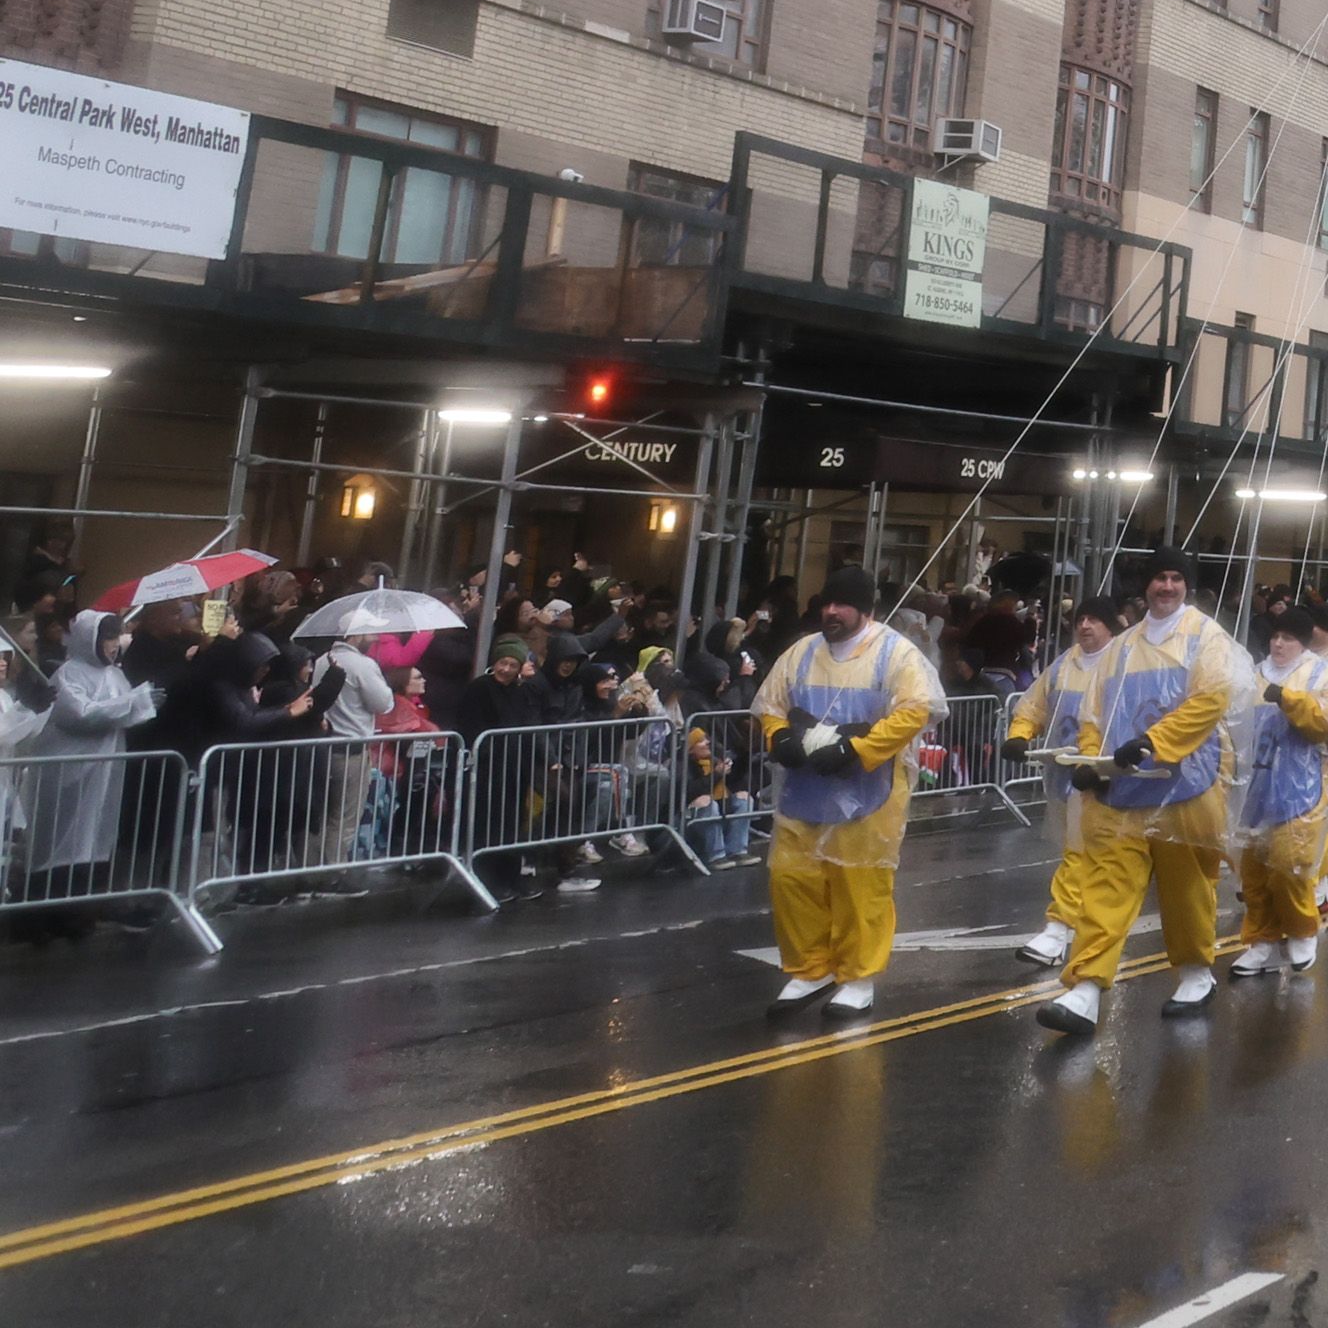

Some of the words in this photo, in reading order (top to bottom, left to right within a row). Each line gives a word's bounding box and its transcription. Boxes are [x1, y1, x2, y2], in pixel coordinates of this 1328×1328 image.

[18, 85, 78, 122] Central
[79, 98, 116, 130] Park
[120, 105, 160, 145] West,
[164, 115, 241, 154] Manhattan
[37, 145, 101, 172] Maspeth
[105, 158, 186, 190] Contracting
[922, 231, 974, 263] KINGS
[914, 292, 975, 315] 718-850-5464
[584, 440, 678, 464] CENTURY
[819, 447, 845, 467] 25
[960, 457, 975, 477] 25
[977, 459, 1005, 480] CPW
